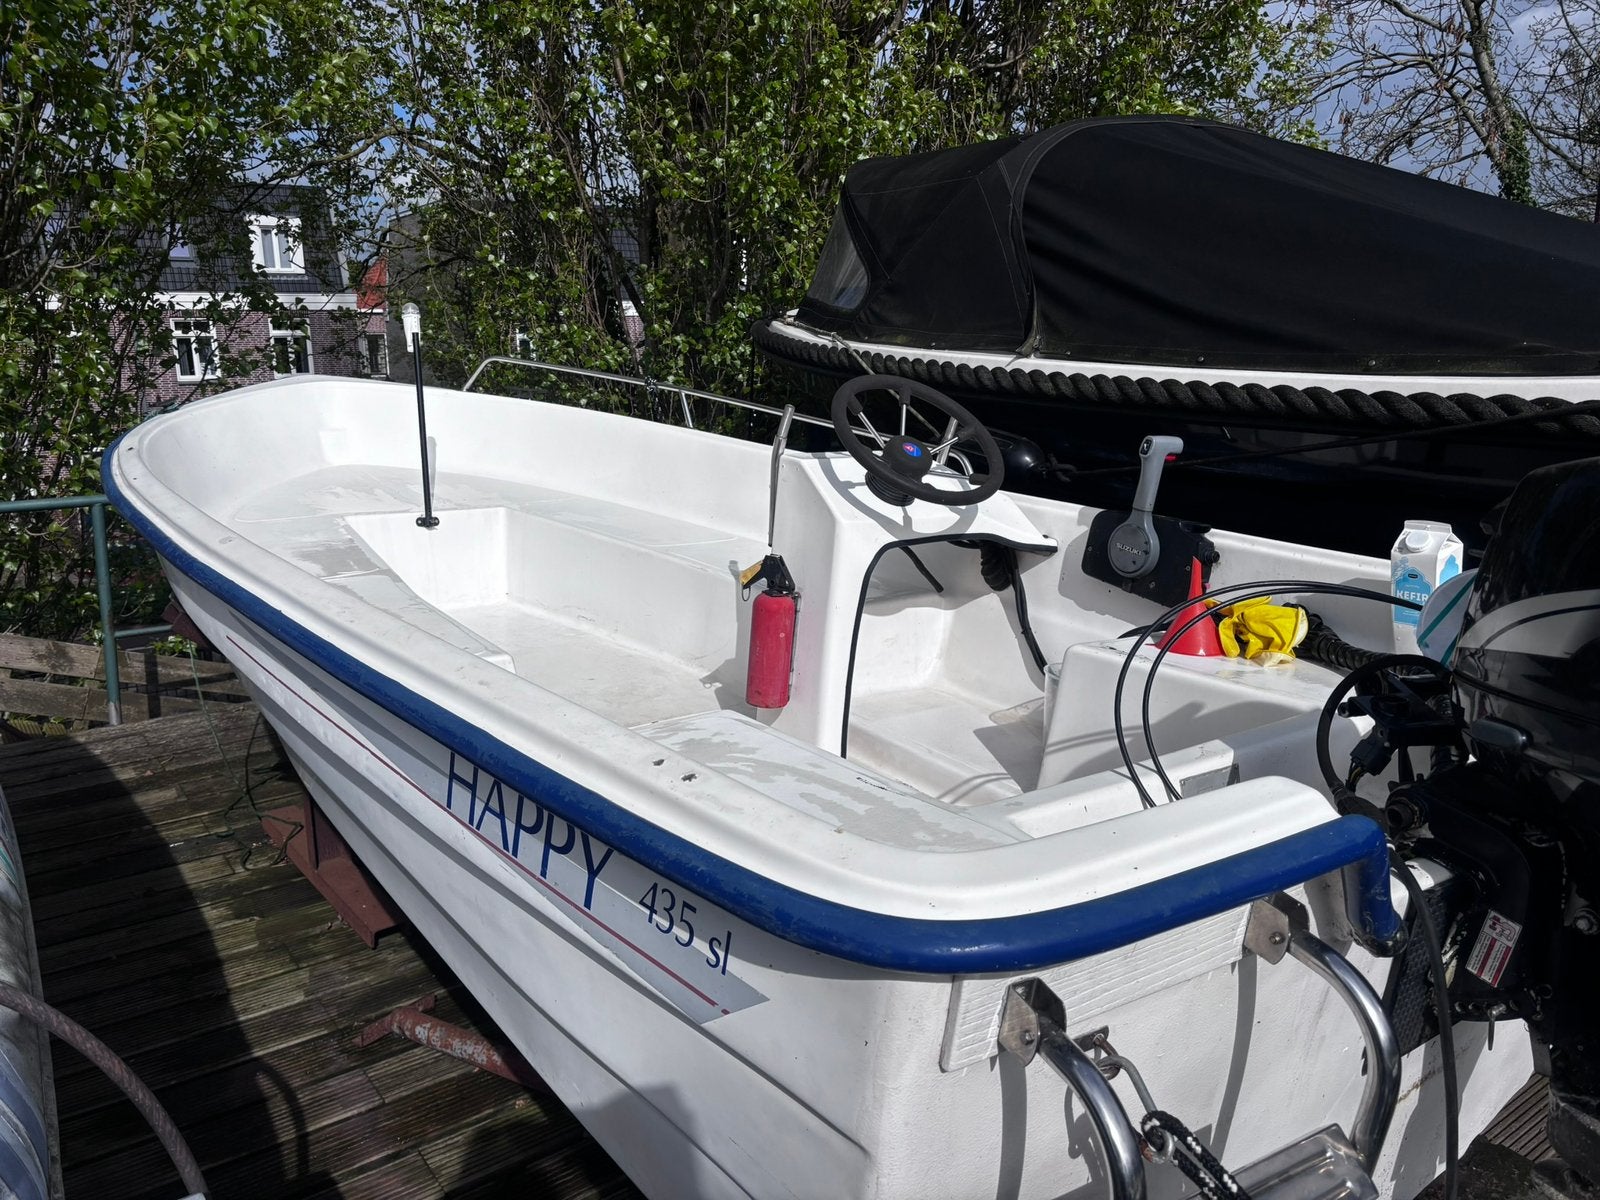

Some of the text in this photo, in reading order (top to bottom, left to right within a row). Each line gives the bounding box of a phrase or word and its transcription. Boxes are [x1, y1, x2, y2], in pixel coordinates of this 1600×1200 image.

[1115, 542, 1142, 555] SUZUKI
[1396, 590, 1429, 602] KEFIR
[446, 752, 732, 976] HAPPY 435 sl
